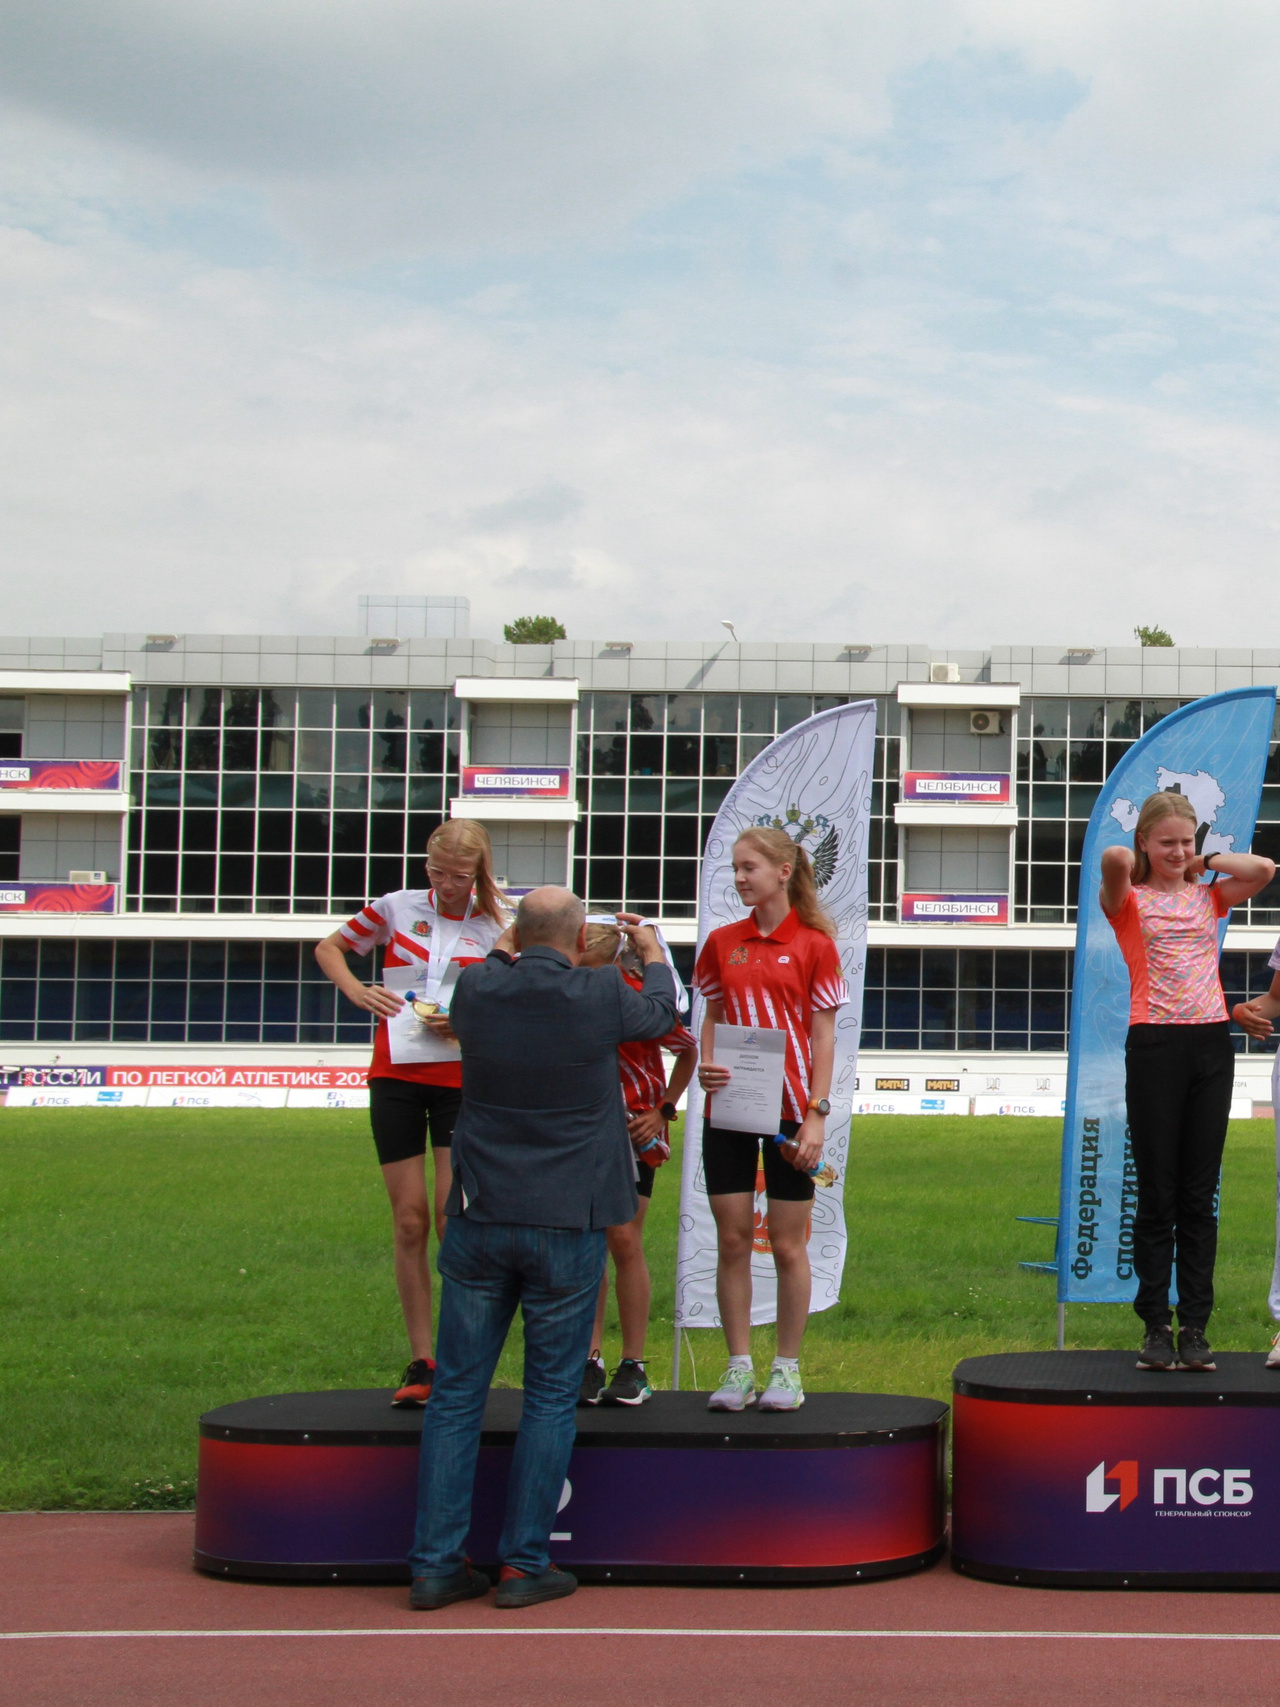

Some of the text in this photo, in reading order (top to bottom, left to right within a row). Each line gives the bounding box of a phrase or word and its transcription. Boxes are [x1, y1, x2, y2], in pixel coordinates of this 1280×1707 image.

[476, 776, 558, 787] ЧЕЛЯБИНСК
[918, 781, 998, 792] ЧЕЛЯБИНСК
[915, 903, 996, 914] ЧЕЛЯБИНСК
[112, 1071, 142, 1085] ПО
[147, 1068, 226, 1085] ЛЕГКОЙ
[231, 1071, 330, 1086] АТЛЕТИКЕ
[335, 1071, 369, 1086] 202
[872, 1104, 895, 1112] ПСБ
[1013, 1106, 1035, 1114] ПСБ
[1070, 1116, 1103, 1280] Федерация
[1153, 1467, 1254, 1505] ПСБ
